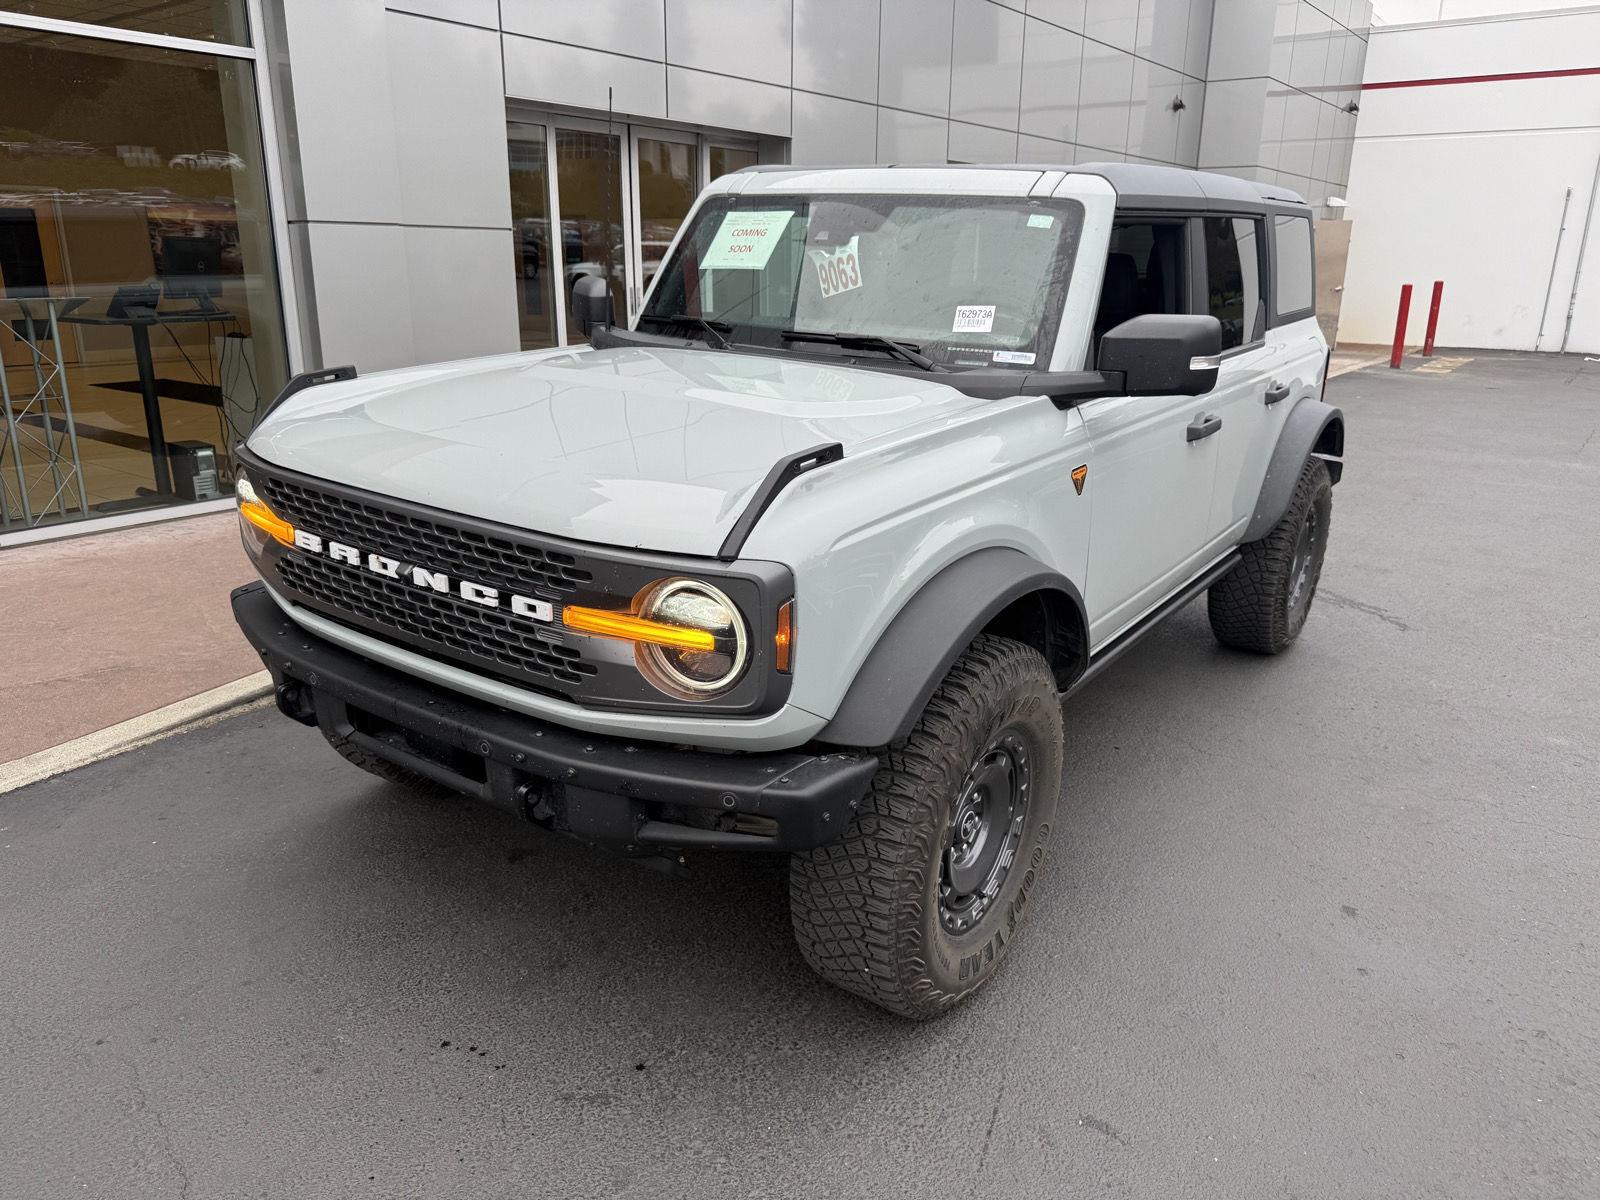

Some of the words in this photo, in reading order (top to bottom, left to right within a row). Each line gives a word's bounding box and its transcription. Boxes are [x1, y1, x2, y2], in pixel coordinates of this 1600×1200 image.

[731, 228, 768, 238] COMING
[727, 244, 754, 254] SOON
[818, 252, 860, 296] 9063
[957, 308, 993, 320] T62973A
[293, 528, 555, 623] BRONCO
